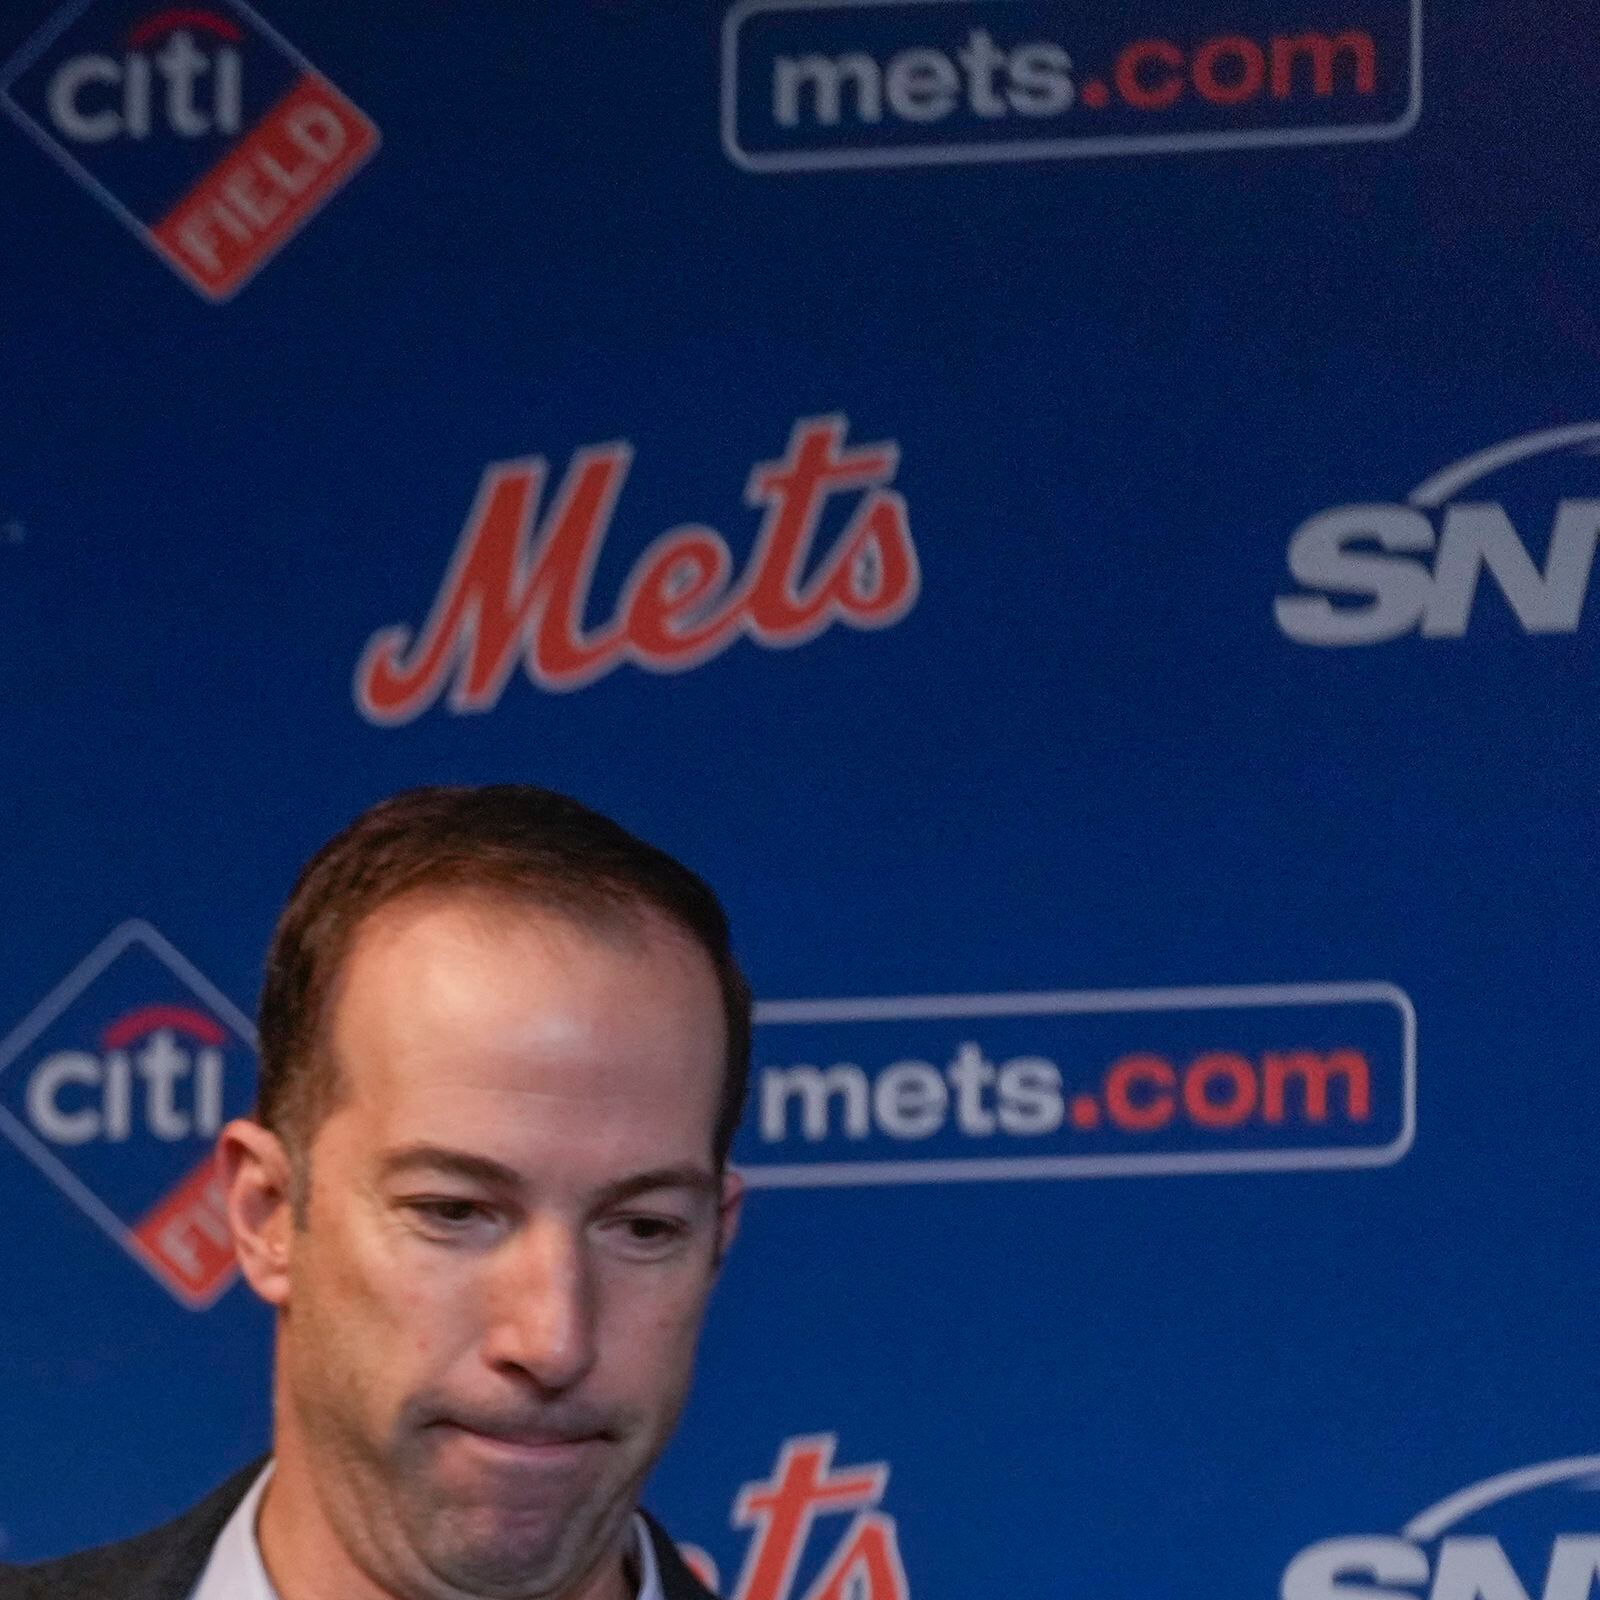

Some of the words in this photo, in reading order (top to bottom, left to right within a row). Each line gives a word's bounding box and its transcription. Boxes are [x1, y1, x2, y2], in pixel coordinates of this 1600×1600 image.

[46, 31, 243, 143] citi
[772, 28, 1378, 126] mets.com
[178, 105, 348, 274] FIELD
[353, 414, 921, 727] Mets
[1273, 501, 1600, 646] SN
[26, 1030, 224, 1144] citi
[758, 1043, 1371, 1142] mets.com
